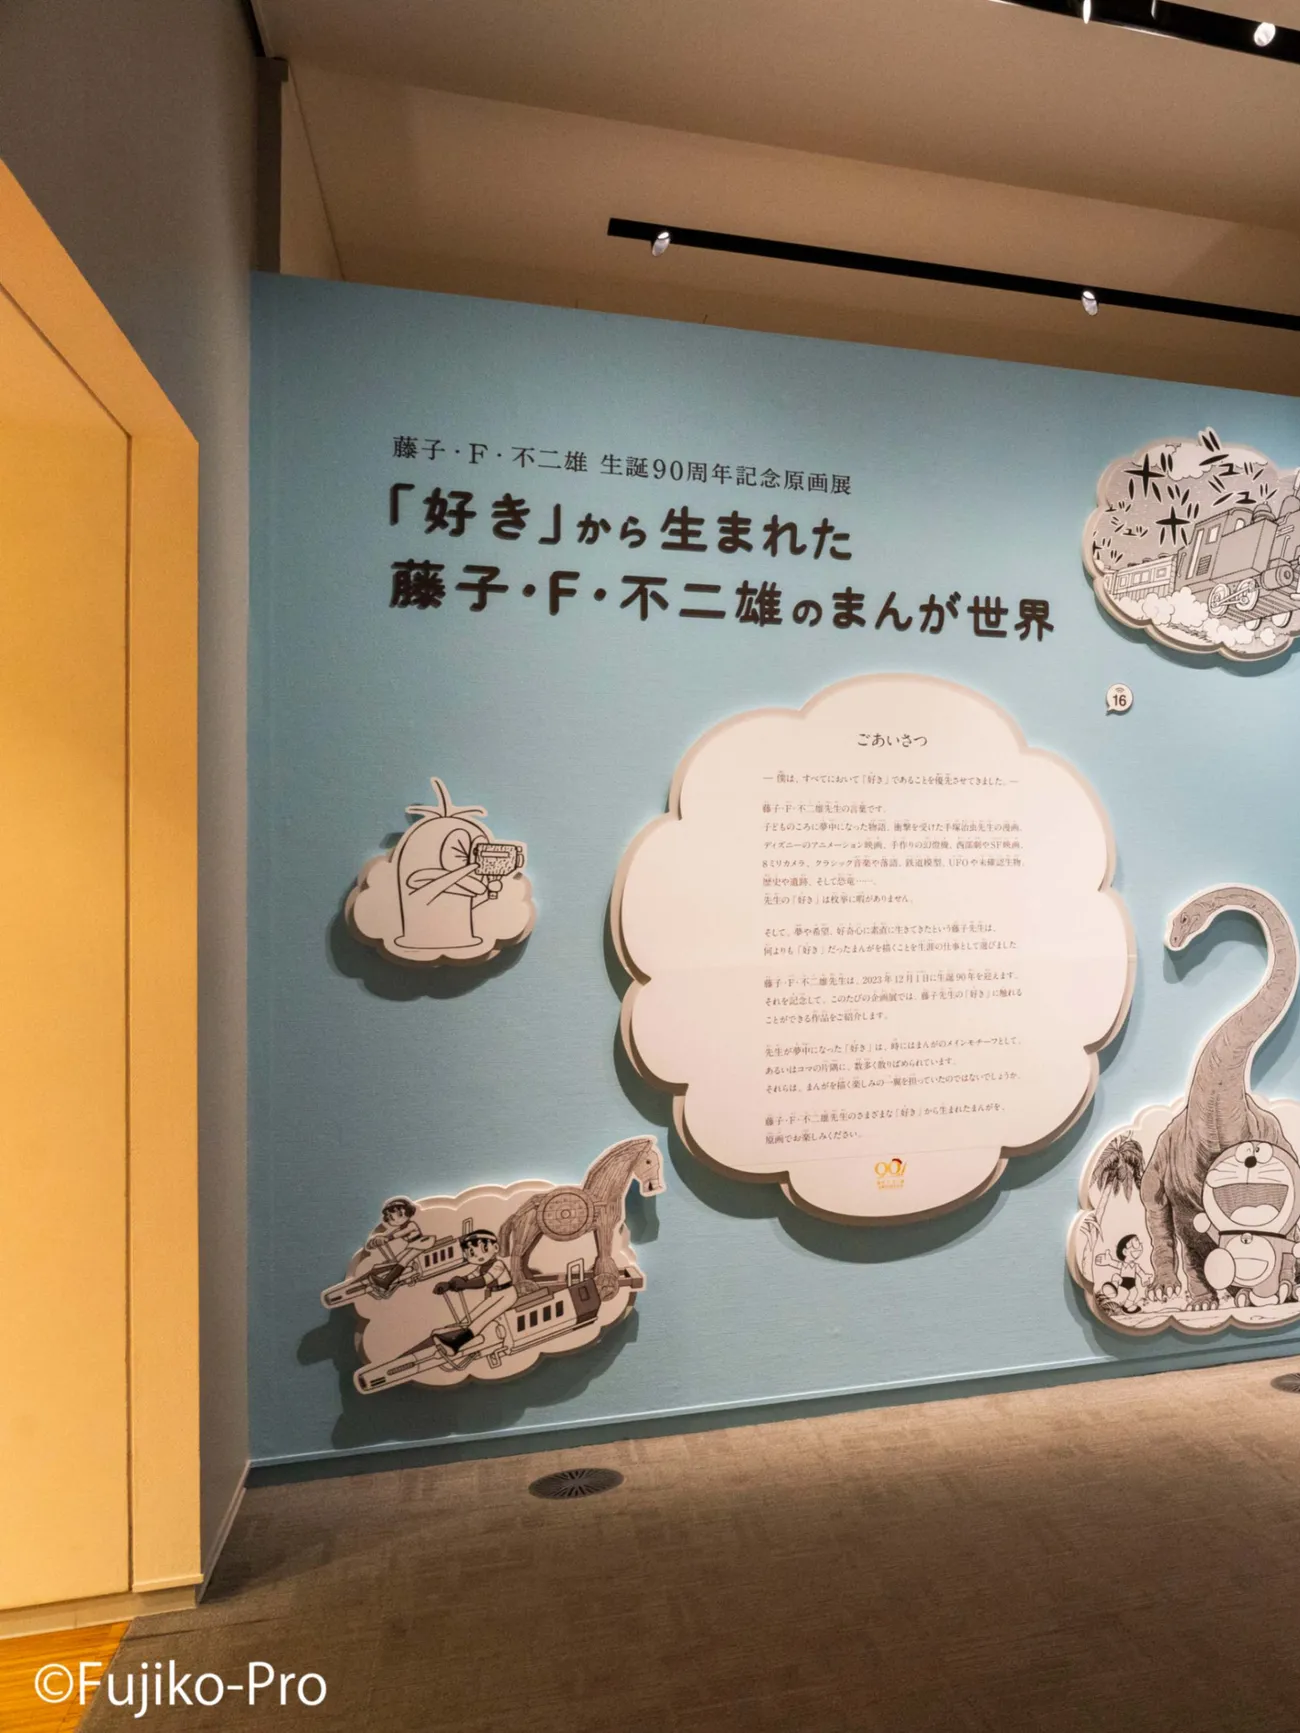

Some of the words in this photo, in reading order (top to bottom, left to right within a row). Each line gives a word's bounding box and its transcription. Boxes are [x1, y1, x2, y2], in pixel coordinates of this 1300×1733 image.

[392, 436, 588, 474] 藤子・F・不二雄
[600, 454, 853, 496] 生誕90周年記念原画展
[388, 482, 853, 562] 「好き」から生まれた
[388, 558, 1055, 642] 藤子・F・不二雄のまんが世界
[1112, 694, 1127, 707] 16
[857, 732, 928, 748] ごあいさつ
